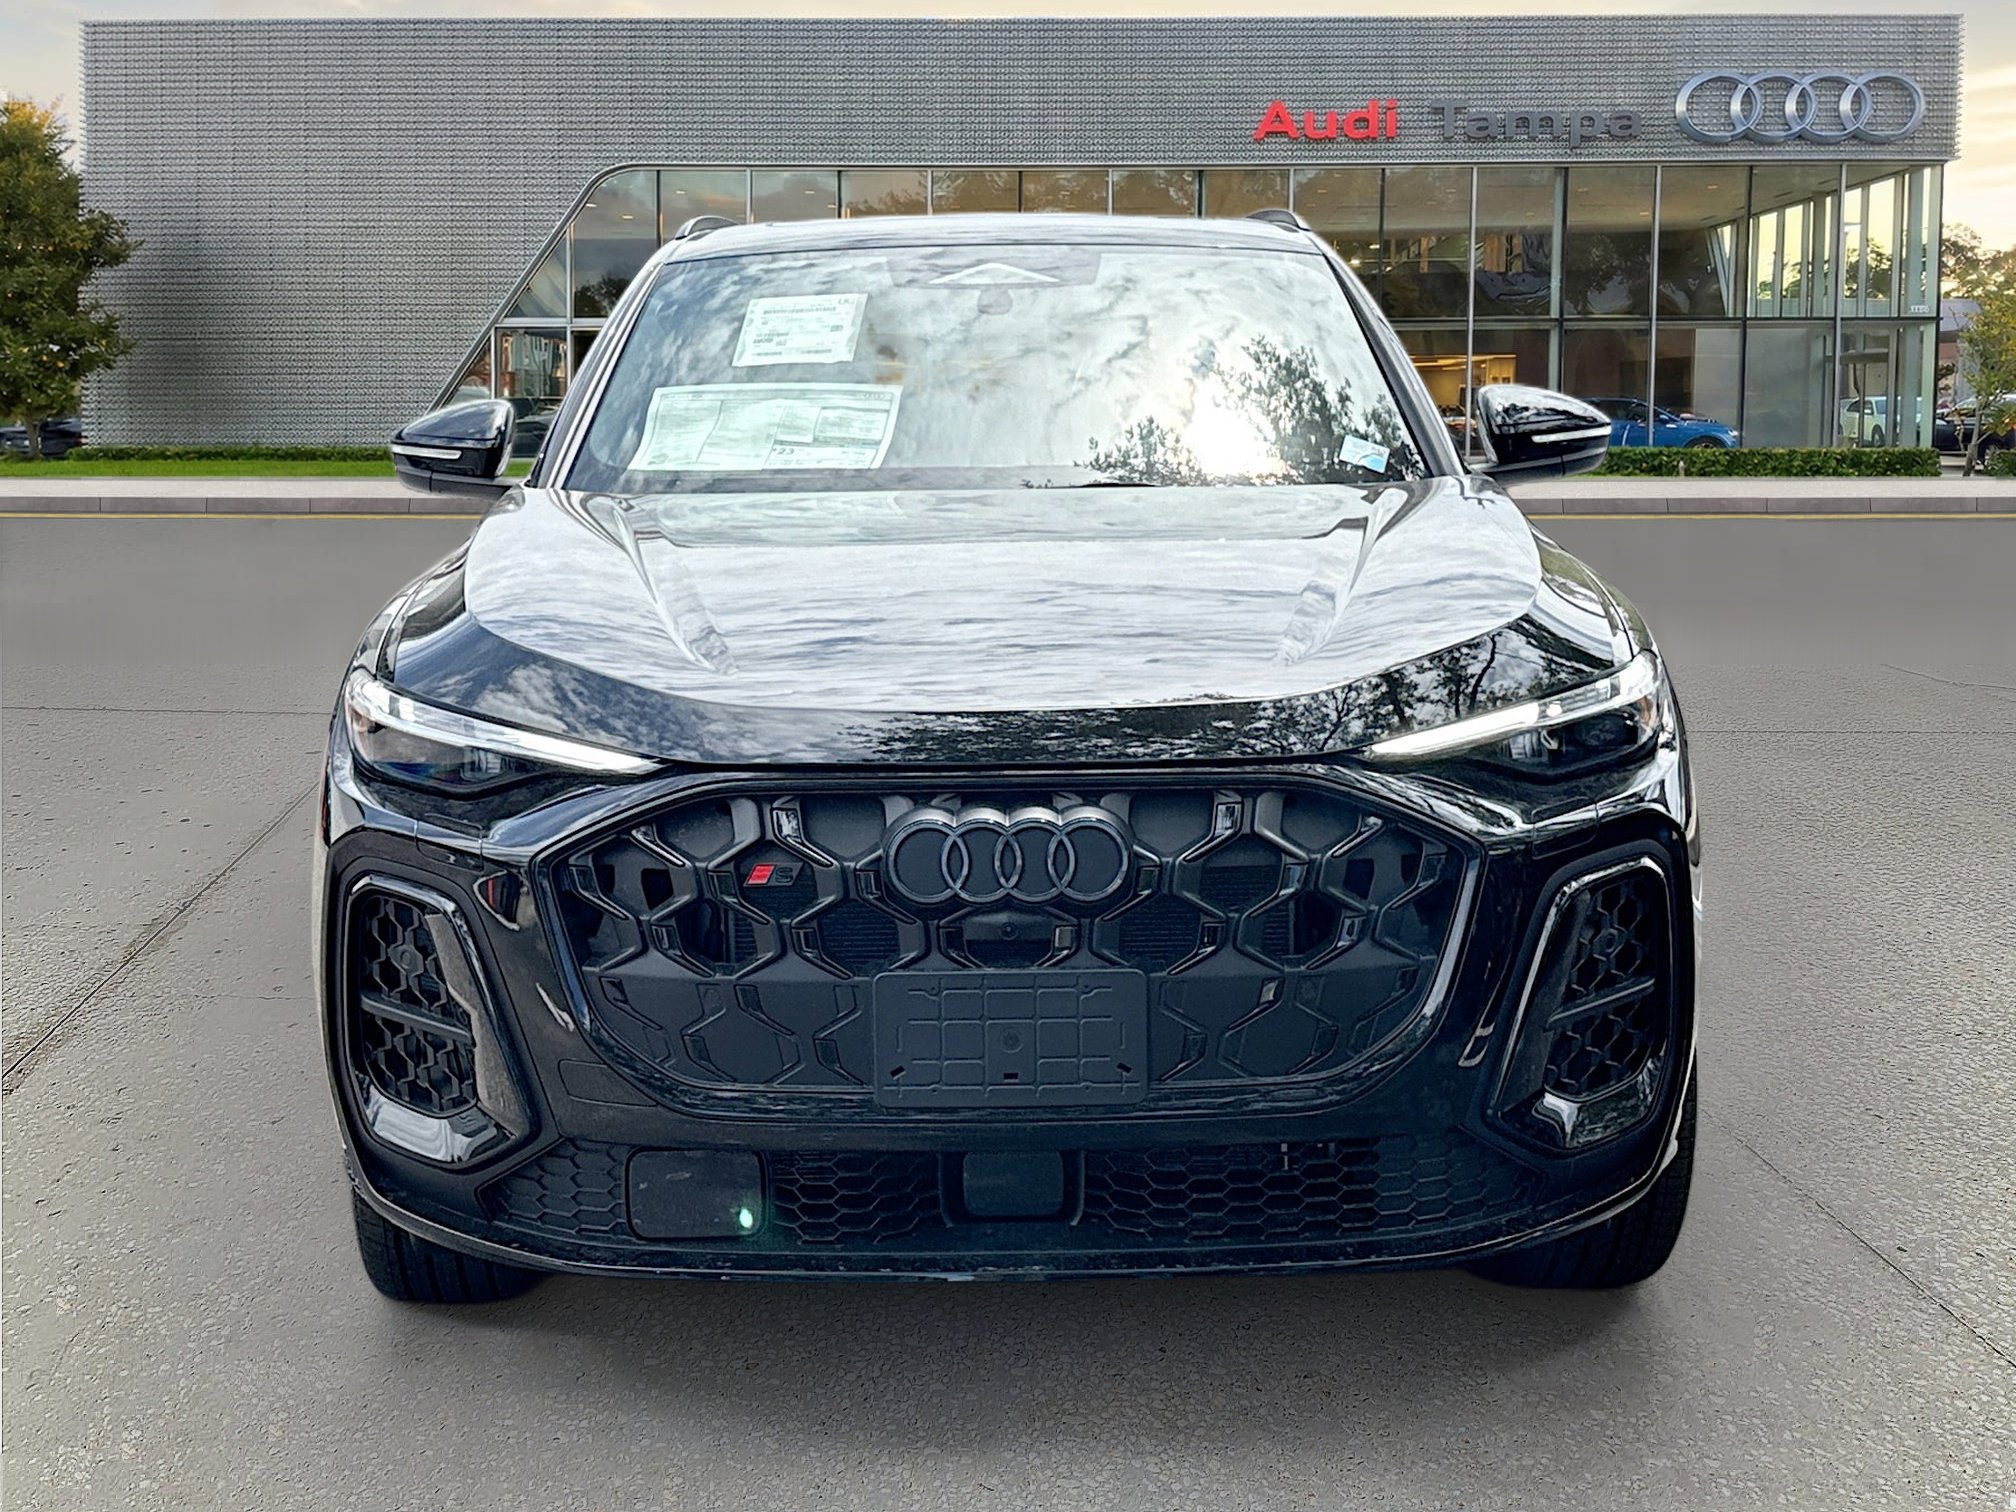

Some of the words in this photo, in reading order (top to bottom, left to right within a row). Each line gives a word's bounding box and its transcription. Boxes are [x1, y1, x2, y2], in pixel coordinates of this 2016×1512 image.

[1253, 99, 1397, 140] Audi
[1431, 101, 1642, 150] Tampa
[774, 866, 794, 883] S
